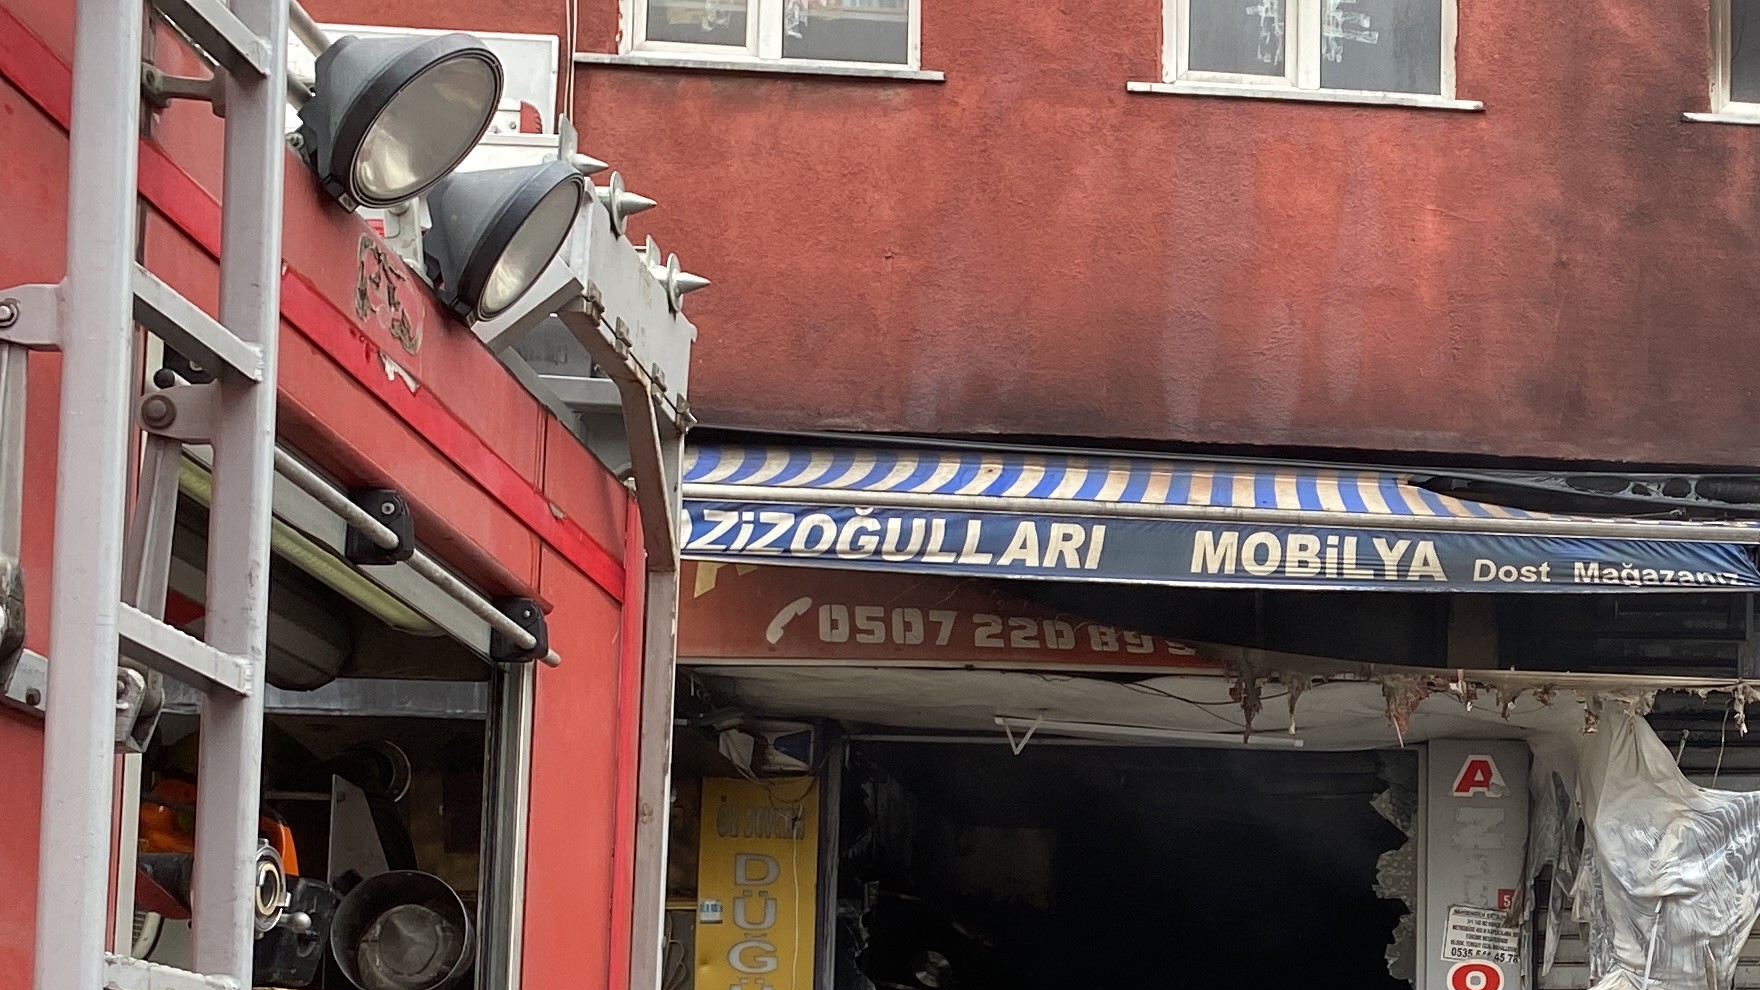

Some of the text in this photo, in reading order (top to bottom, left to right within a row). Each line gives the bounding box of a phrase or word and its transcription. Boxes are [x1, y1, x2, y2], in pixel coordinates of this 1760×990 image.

[681, 507, 1106, 570] ZiZOĞULLARI
[1473, 558, 1550, 583] Dost
[818, 603, 957, 646] 0507
[973, 613, 1077, 650] 220
